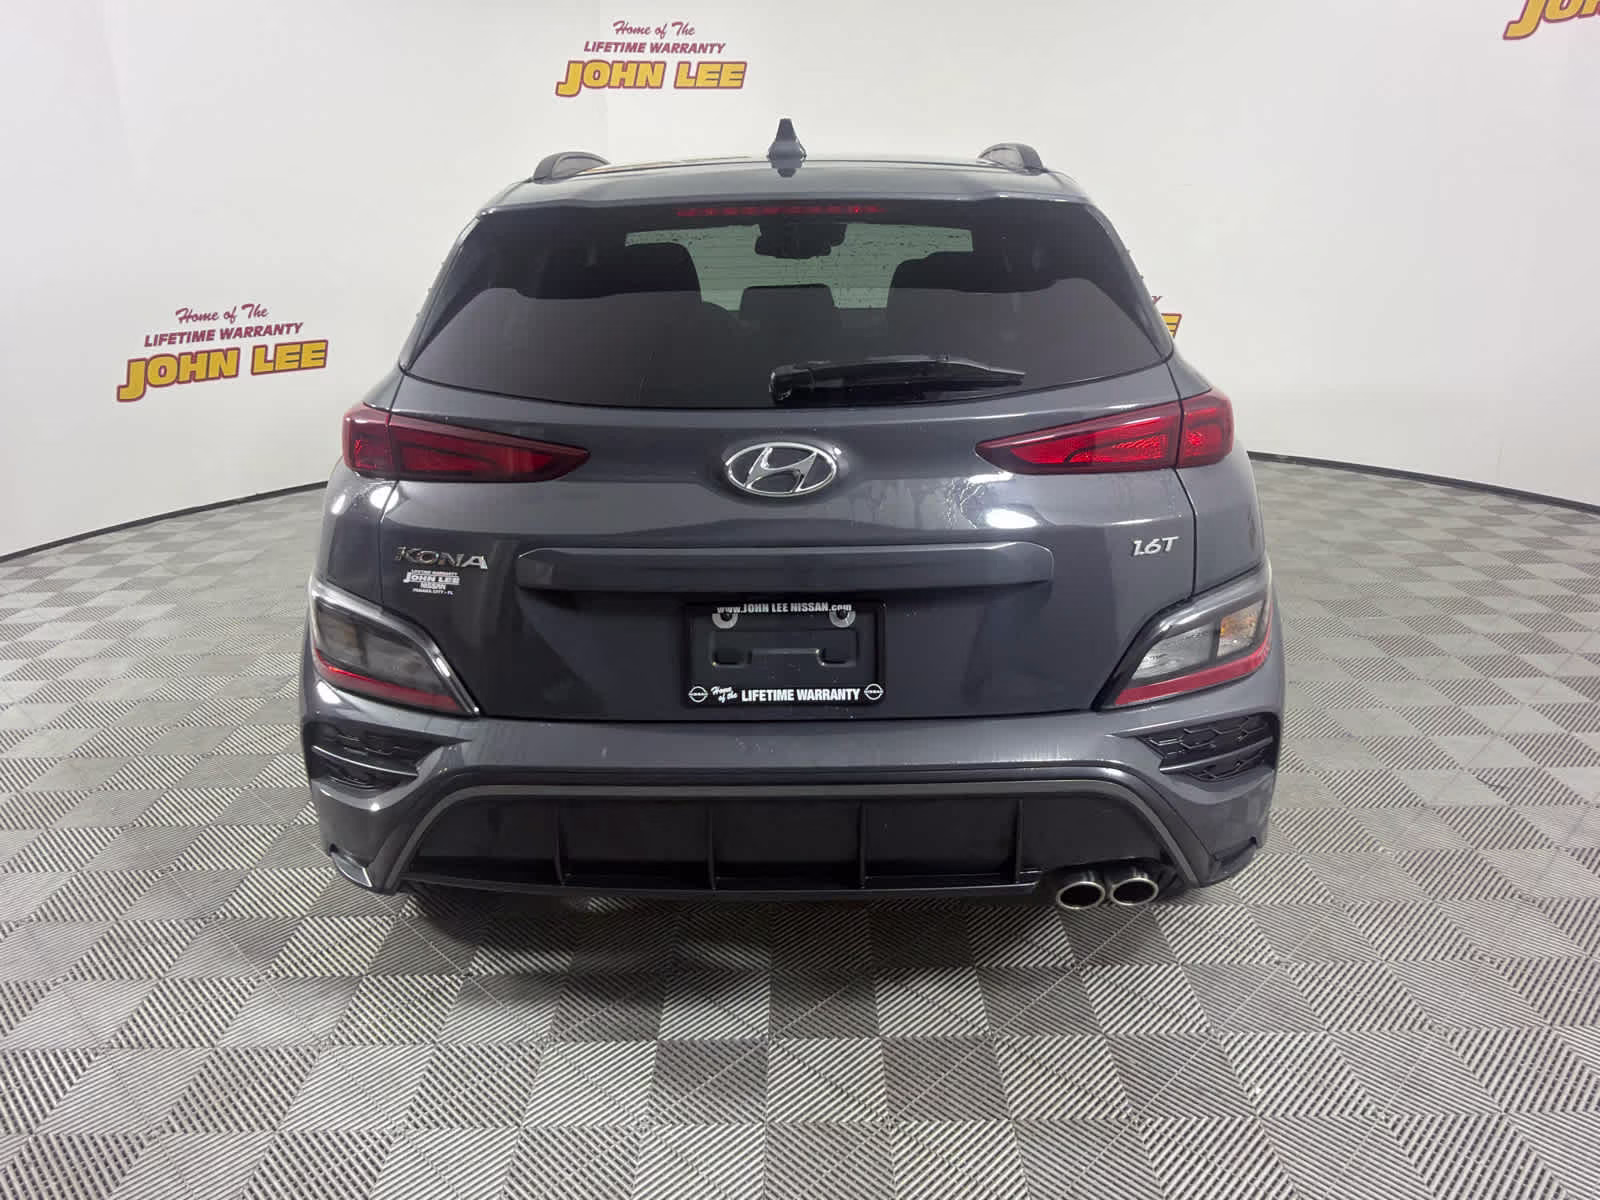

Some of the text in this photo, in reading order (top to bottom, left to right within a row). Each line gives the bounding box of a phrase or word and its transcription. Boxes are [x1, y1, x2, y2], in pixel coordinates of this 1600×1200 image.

[613, 20, 695, 39] Home of The
[584, 41, 726, 54] LIFETIME WARRANTY
[555, 59, 747, 97] JOHN LEE
[175, 303, 269, 324] Home of The
[144, 322, 304, 347] LIFETIME WARRANTY
[116, 339, 328, 403] JOHN LEE
[395, 546, 488, 570] KONA
[403, 572, 436, 583] JOHN
[772, 603, 788, 612] LEE
[741, 688, 861, 702] LIFETIME WARRANTY
